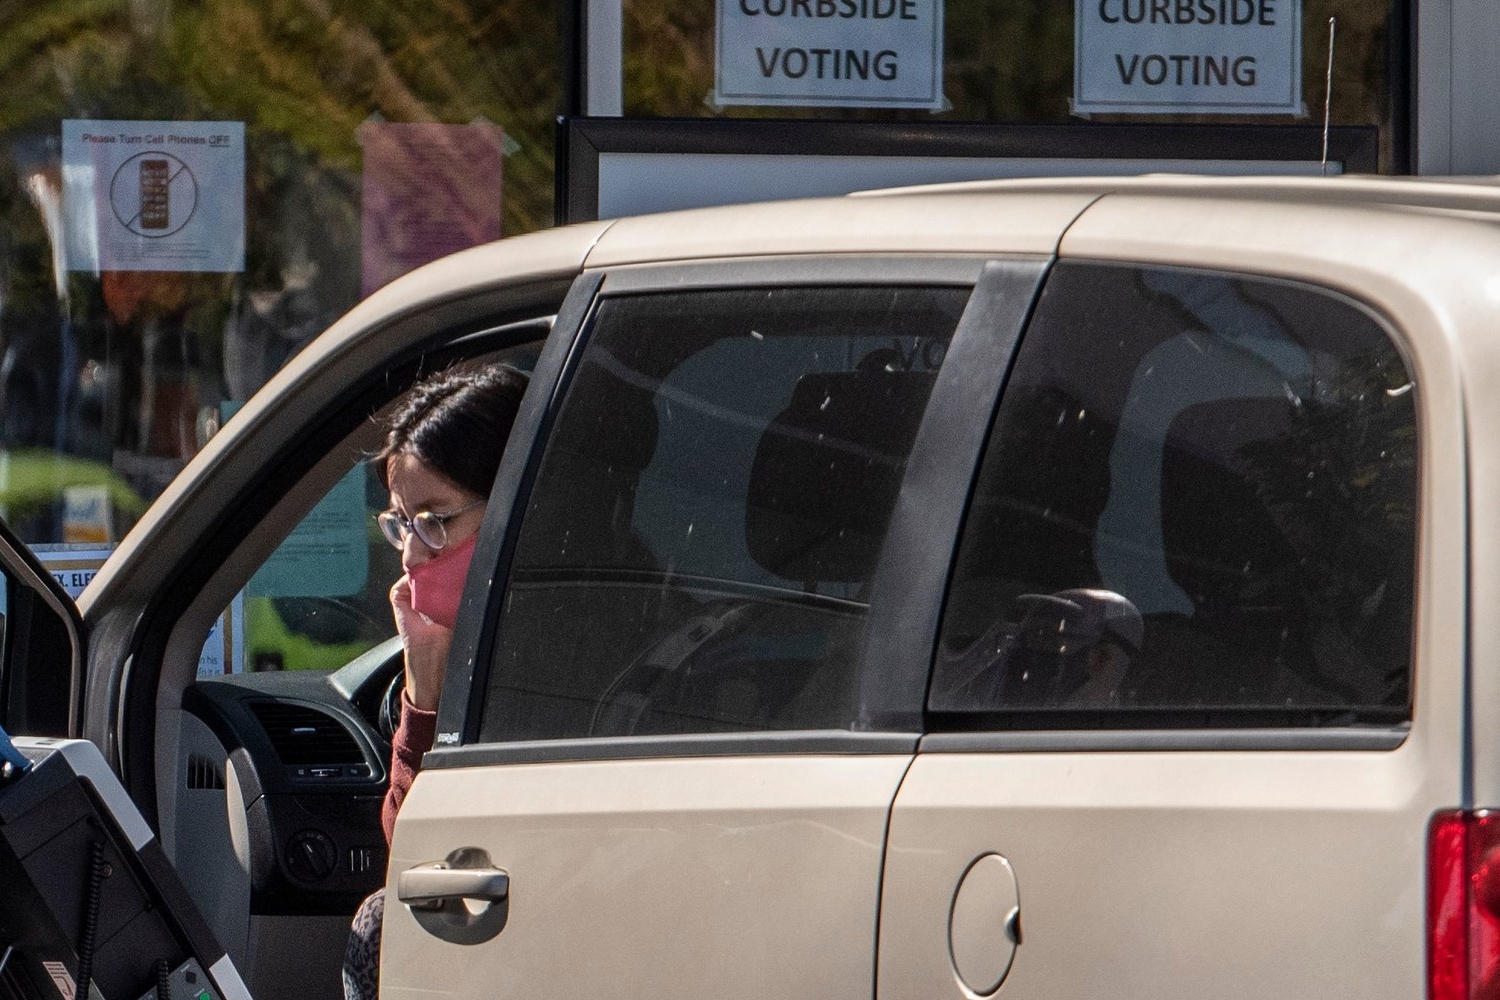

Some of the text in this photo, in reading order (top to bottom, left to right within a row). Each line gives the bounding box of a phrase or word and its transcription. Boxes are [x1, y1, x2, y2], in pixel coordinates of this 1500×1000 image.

[740, 0, 918, 20] CURBSIDE
[1099, 0, 1276, 26] CURBSIDE
[756, 47, 898, 81] VOTING
[1114, 54, 1256, 87] VOTING
[81, 133, 230, 147] Please Turn Cell Phones OFF
